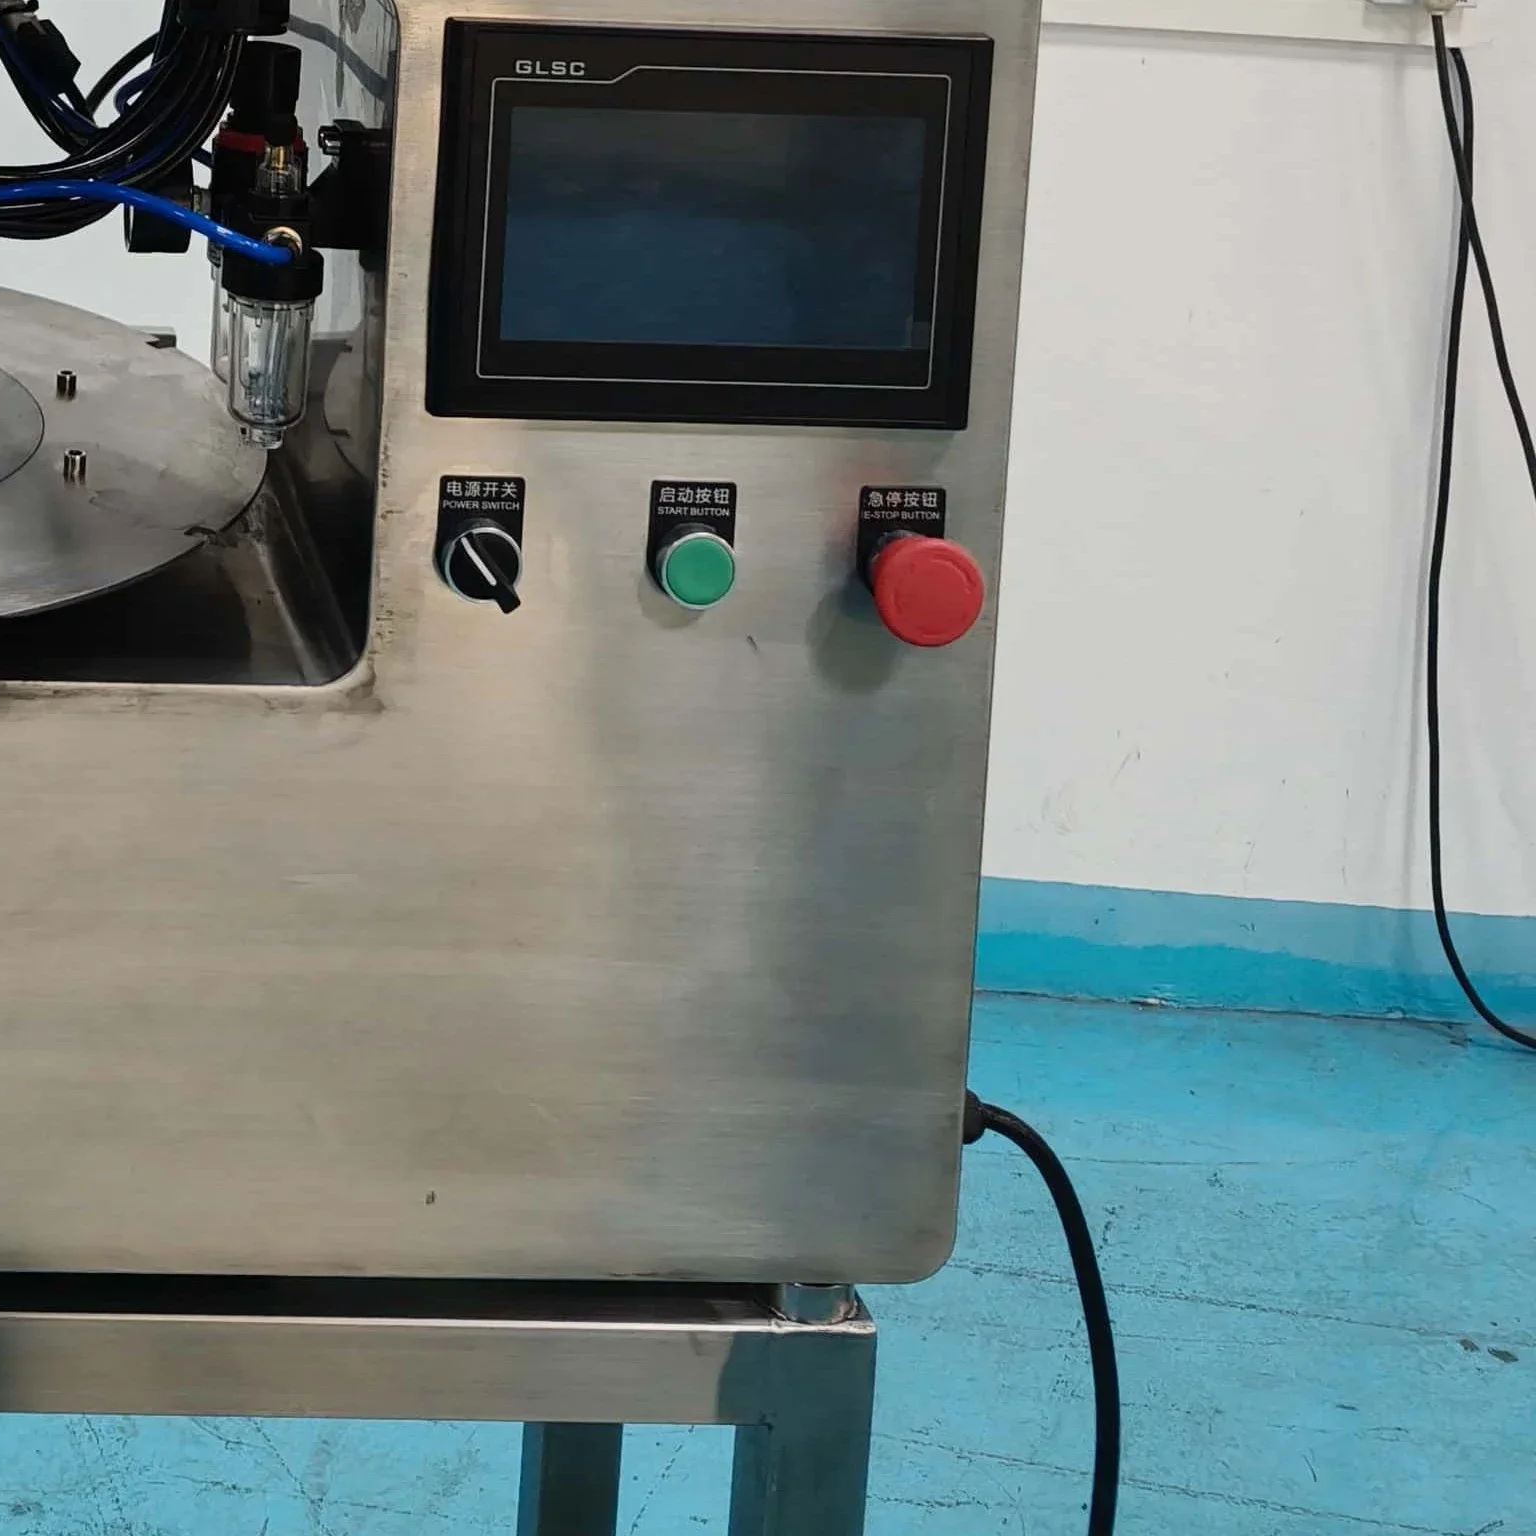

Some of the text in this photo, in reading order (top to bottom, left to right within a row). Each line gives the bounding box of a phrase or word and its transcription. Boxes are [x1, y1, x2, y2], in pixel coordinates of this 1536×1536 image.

[515, 59, 585, 76] GLSC
[446, 480, 518, 498] 电源开关
[659, 486, 730, 504] 启动按钮
[443, 499, 520, 511] POWER SWITCH
[867, 491, 938, 508] 急停按钮
[657, 506, 730, 517] START BUTTON
[863, 510, 940, 520] E-STOP BUTTON
